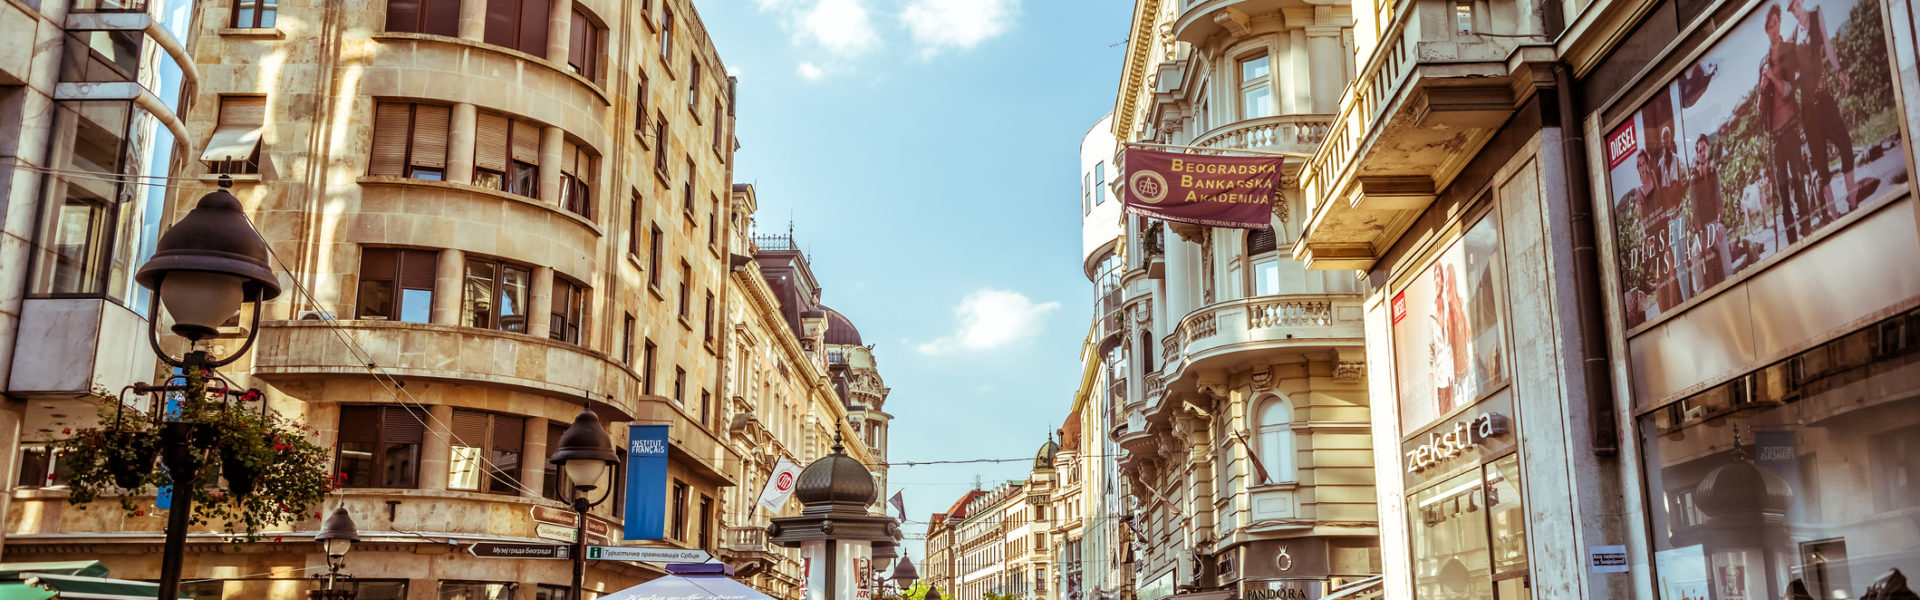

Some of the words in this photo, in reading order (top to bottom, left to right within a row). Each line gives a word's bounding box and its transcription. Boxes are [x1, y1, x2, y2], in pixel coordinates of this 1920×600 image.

[1610, 126, 1635, 161] DIESEL
[1171, 158, 1276, 174] BEOGRADSKA
[1180, 174, 1272, 189] BANKARSKA
[1184, 190, 1269, 205] AKADEMIJA
[1630, 217, 1686, 271] DIESEL
[1656, 223, 1716, 279] ISLAND
[631, 446, 665, 454] FRANÇAIS
[1406, 412, 1493, 473] zekstra
[492, 546, 508, 555] Музеј
[525, 547, 552, 555] Београда
[641, 551, 679, 559] организација
[680, 552, 700, 560] Србије
[856, 590, 870, 598] KFC
[1248, 588, 1306, 600] PANDORA
